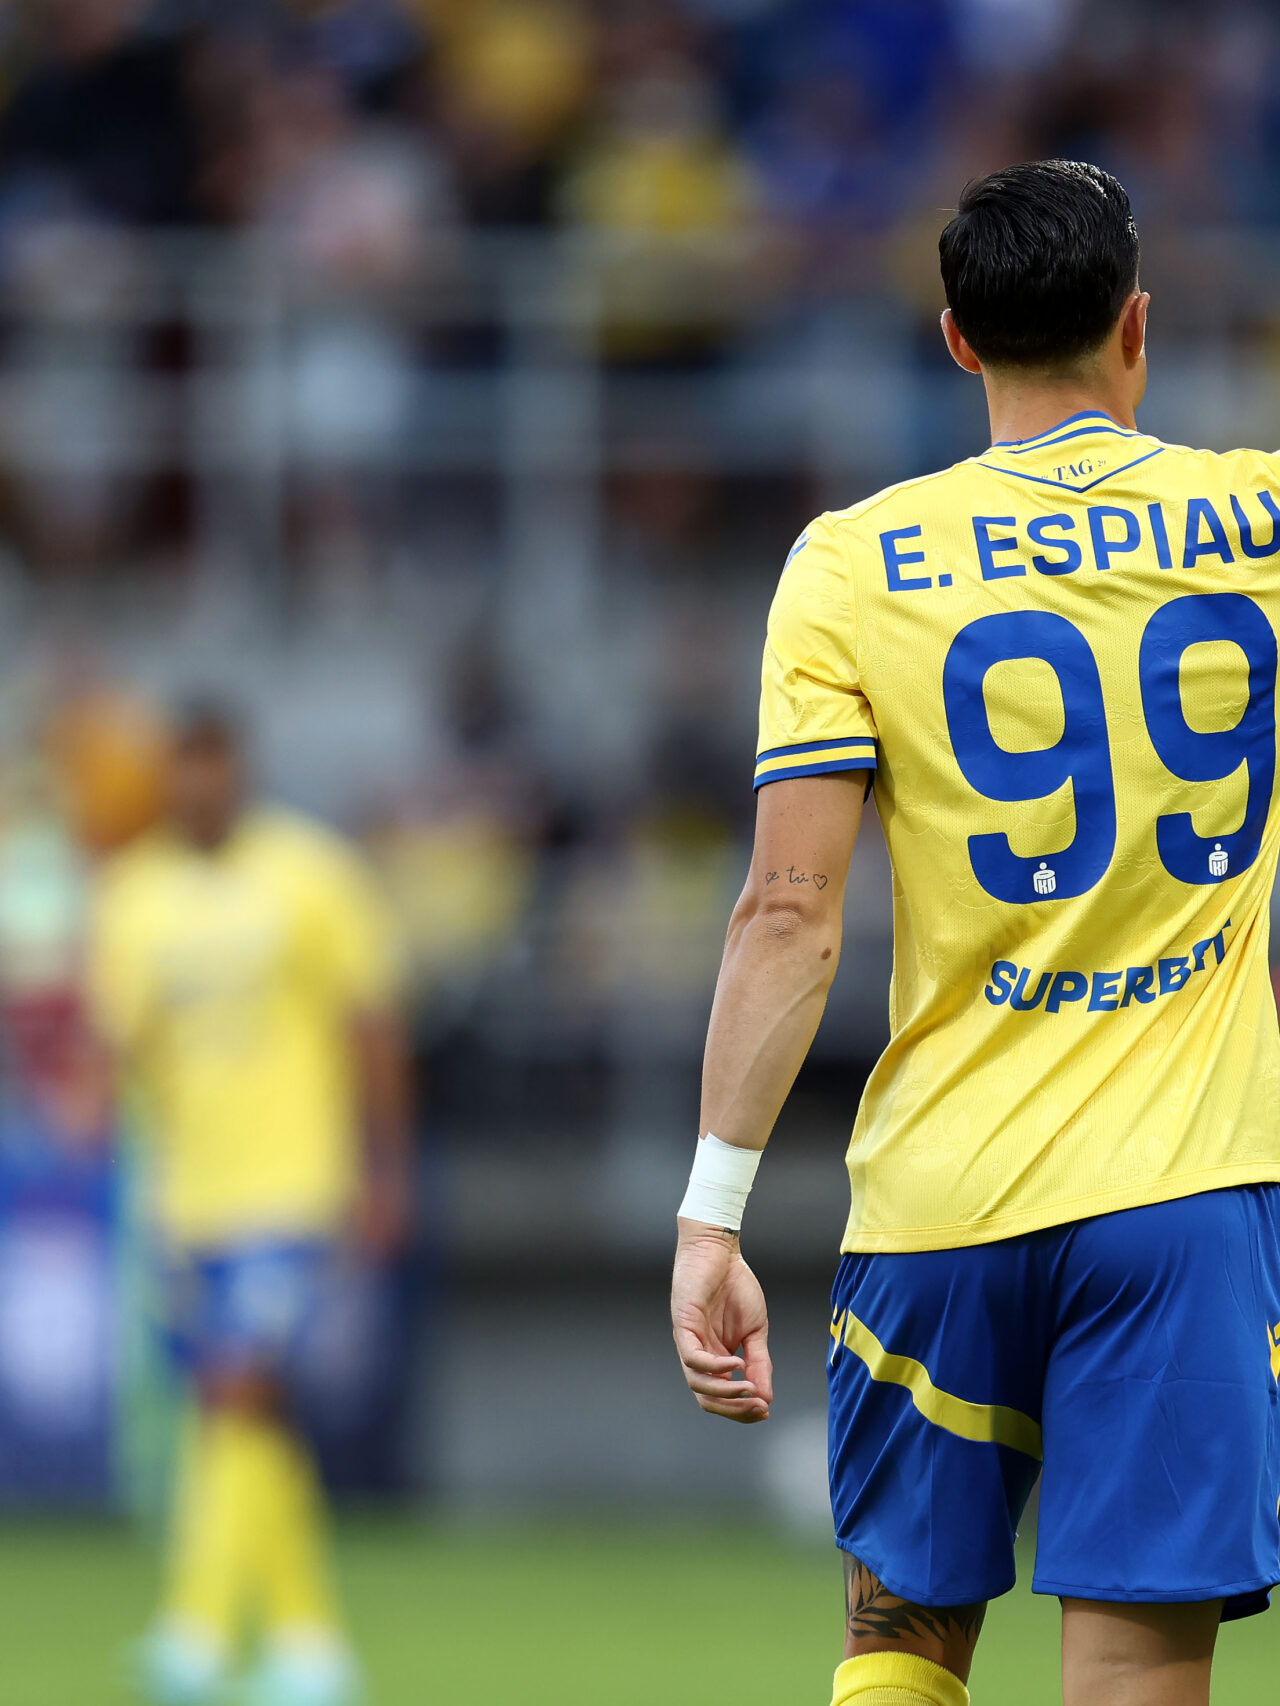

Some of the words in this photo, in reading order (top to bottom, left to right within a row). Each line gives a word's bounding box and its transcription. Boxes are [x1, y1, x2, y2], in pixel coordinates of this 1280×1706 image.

[1053, 459, 1093, 481] TAG
[879, 525, 952, 592] E.
[943, 592, 1278, 905] 99
